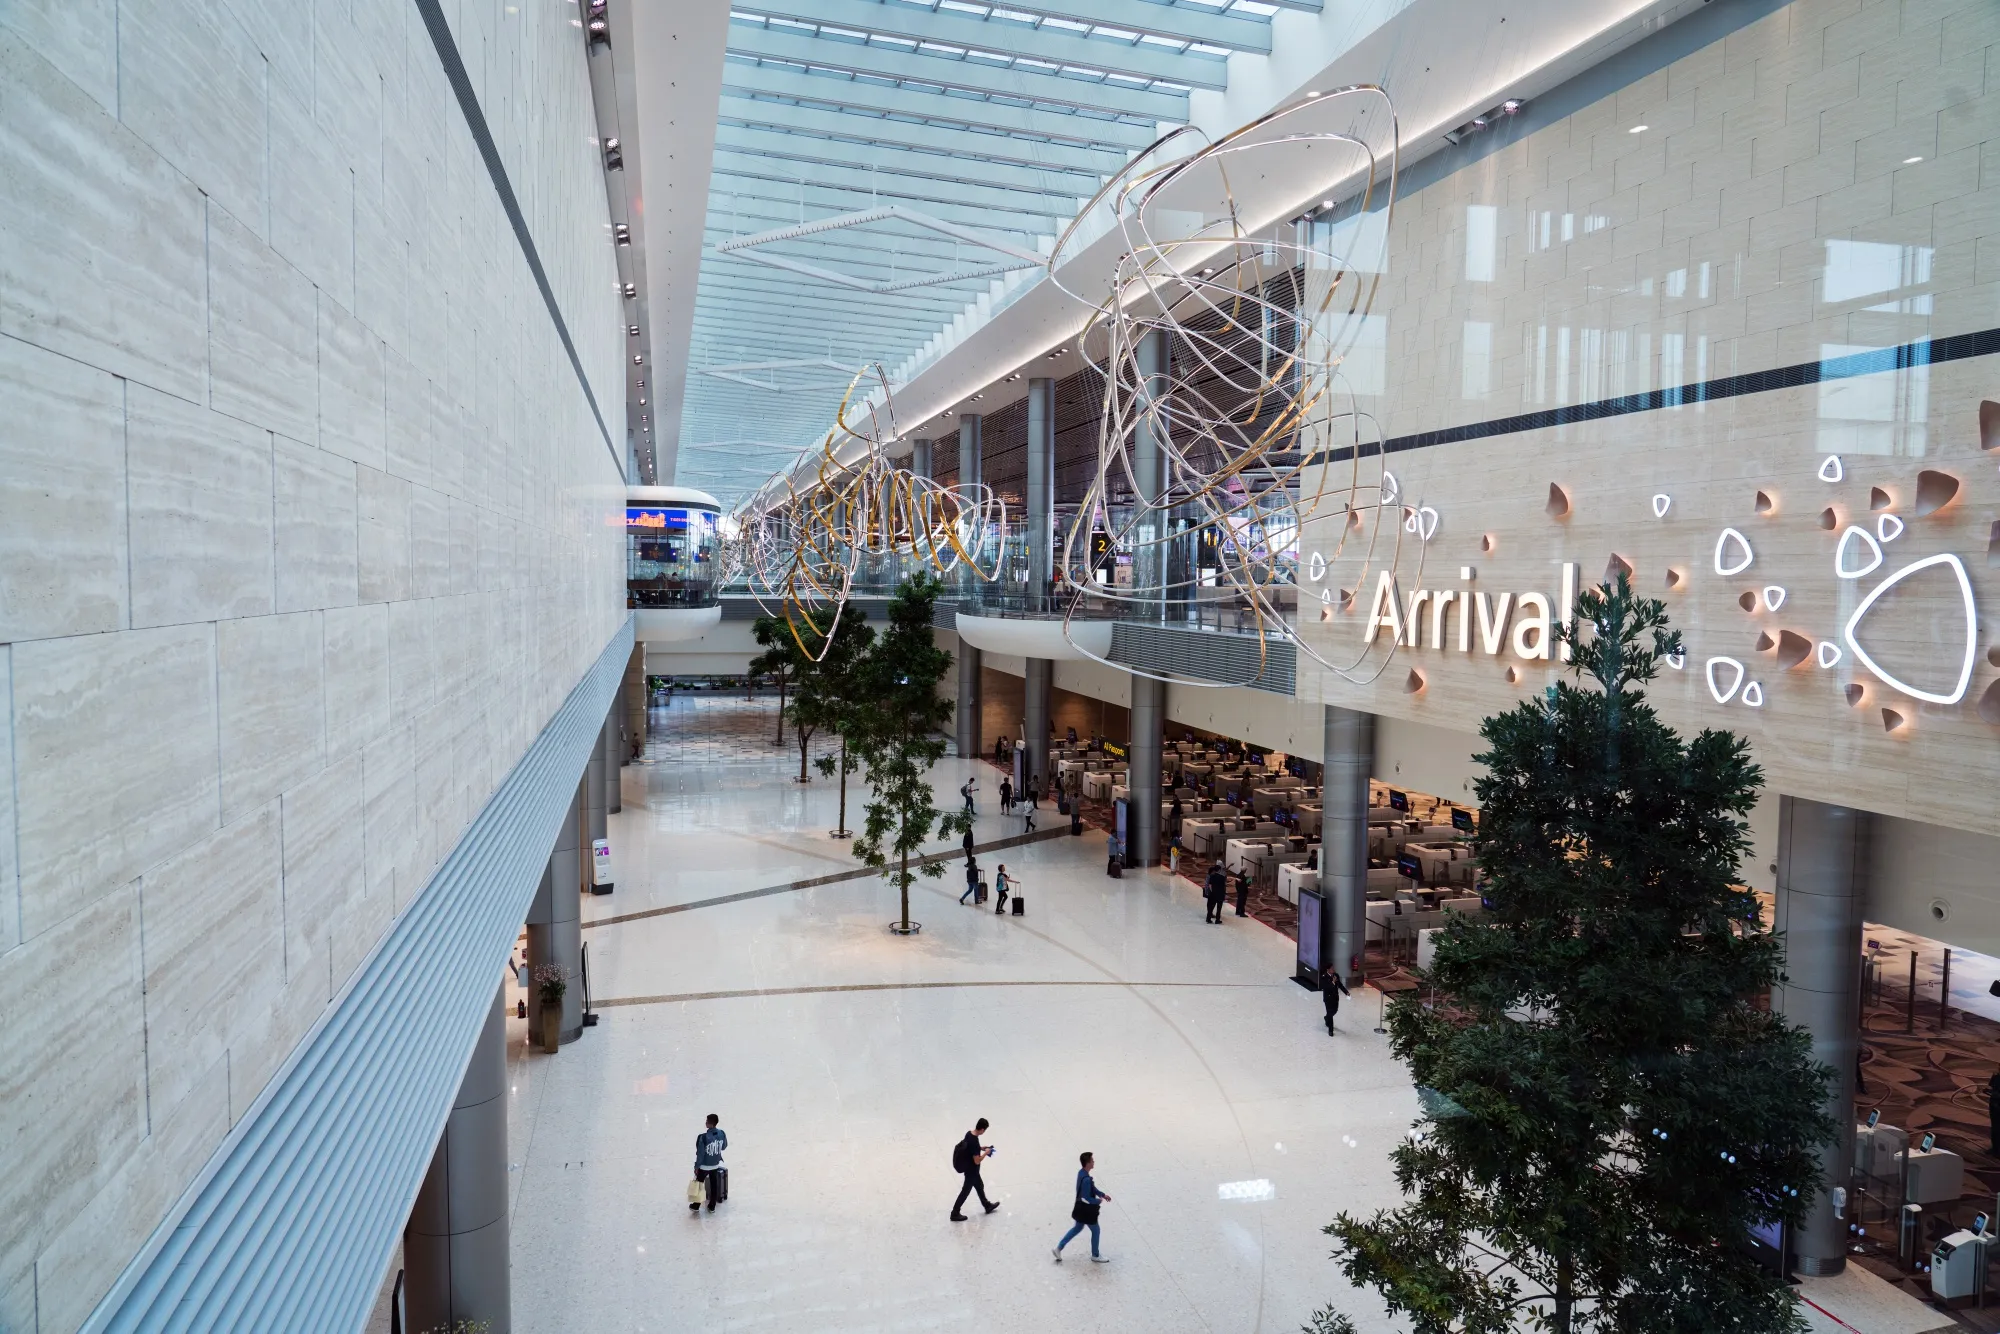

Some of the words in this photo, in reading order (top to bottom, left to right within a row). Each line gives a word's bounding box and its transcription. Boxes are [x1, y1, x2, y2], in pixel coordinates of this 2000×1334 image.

[1098, 540, 1106, 552] 2
[1364, 562, 1578, 661] Arrival
[1109, 744, 1124, 756] Passports
